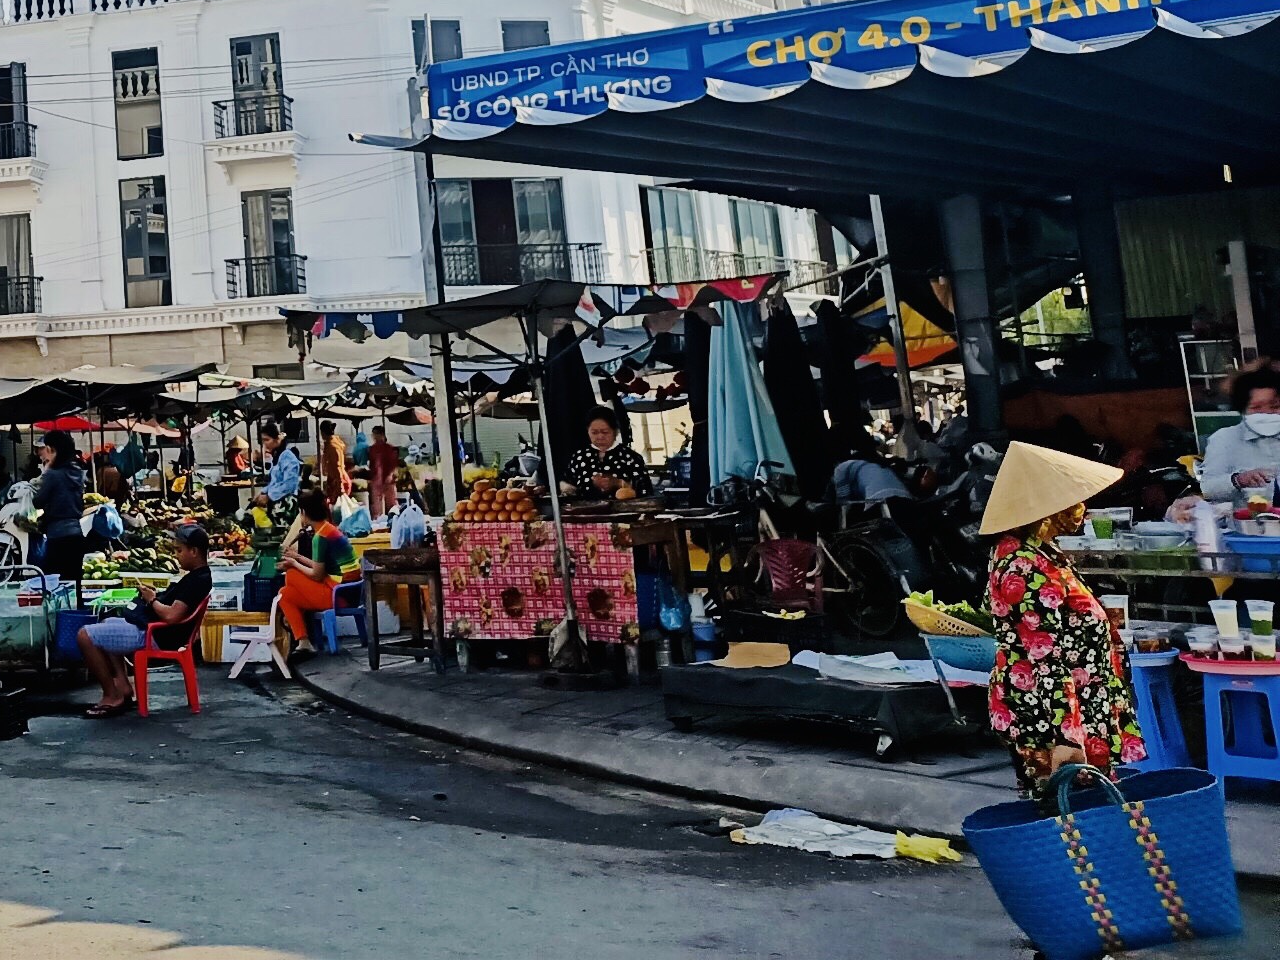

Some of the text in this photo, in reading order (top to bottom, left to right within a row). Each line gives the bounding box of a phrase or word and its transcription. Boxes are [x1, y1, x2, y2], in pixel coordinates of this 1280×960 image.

[746, 27, 846, 67] CHỢ
[857, 15, 932, 50] 4.0
[451, 47, 649, 92] UBND TP. CẦN THƠ
